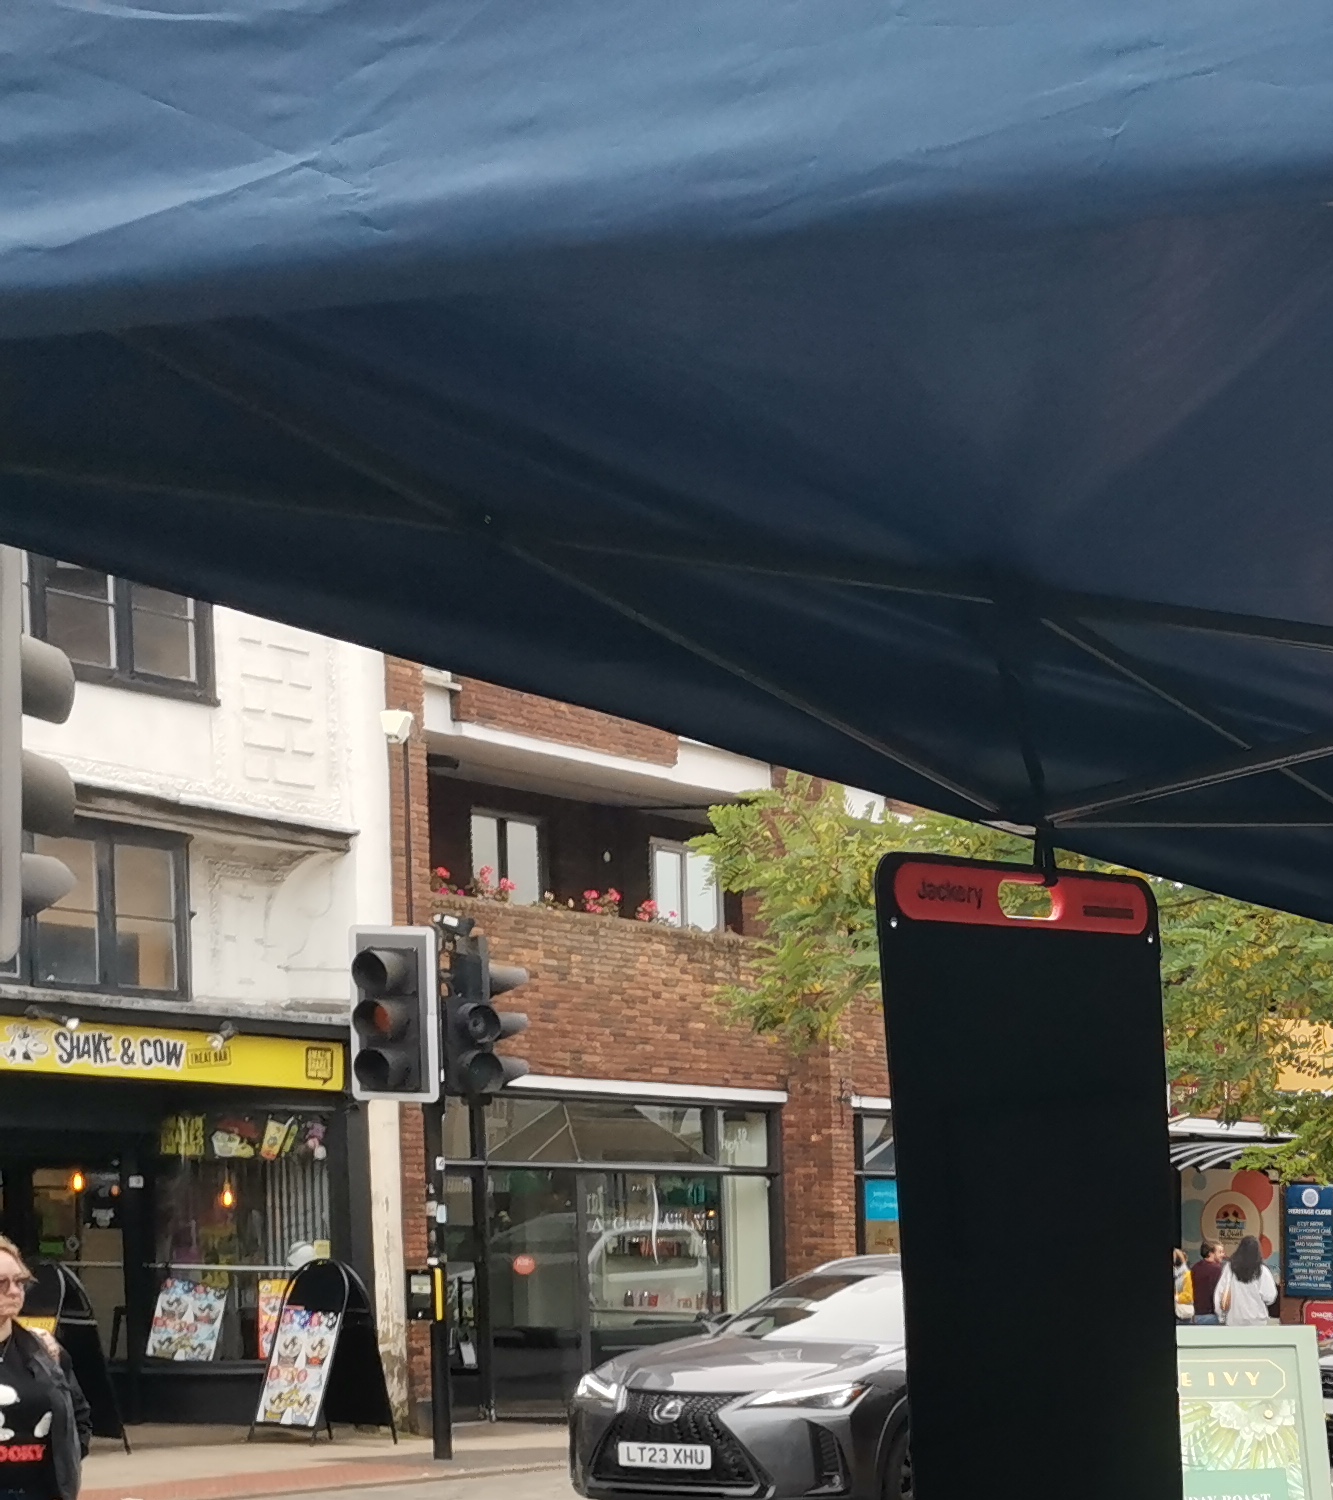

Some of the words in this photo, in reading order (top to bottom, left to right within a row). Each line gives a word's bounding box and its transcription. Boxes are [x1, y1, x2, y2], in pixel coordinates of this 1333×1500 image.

[918, 879, 983, 909] Jackery
[54, 1031, 116, 1064] SHAKE
[120, 1038, 136, 1065] &
[140, 1038, 185, 1068] COW
[1208, 1371, 1260, 1386] IVY
[626, 1446, 668, 1463] LT23
[673, 1447, 705, 1465] XHU
